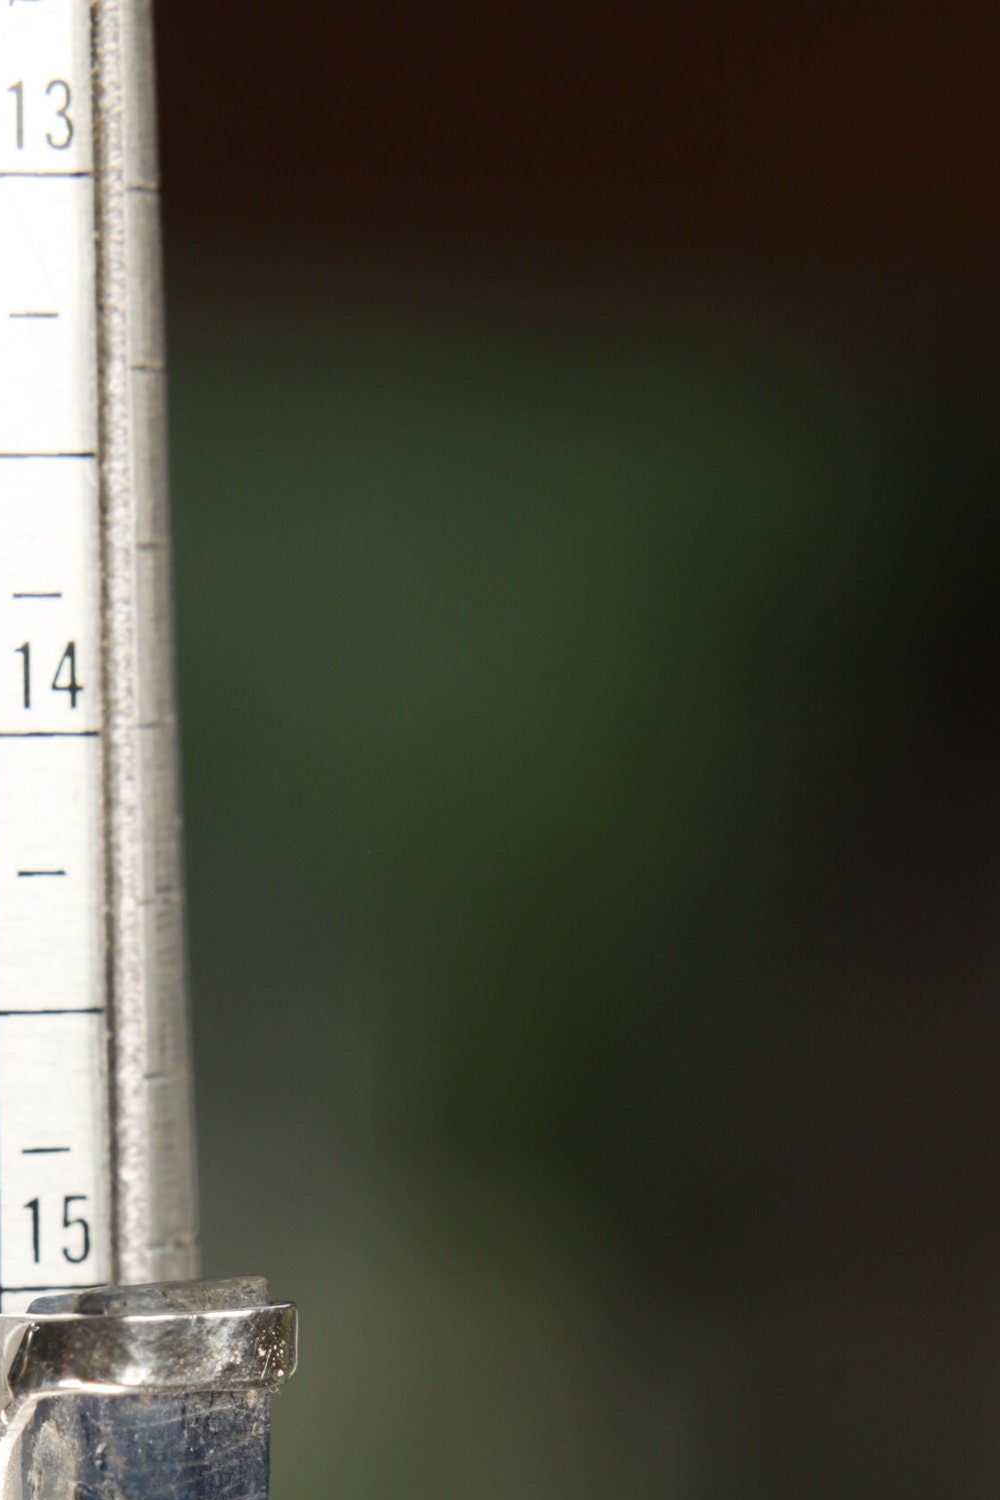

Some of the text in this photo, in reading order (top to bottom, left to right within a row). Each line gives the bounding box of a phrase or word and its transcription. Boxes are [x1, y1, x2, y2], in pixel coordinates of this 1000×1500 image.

[6, 81, 76, 151] 13
[14, 640, 84, 709] 14
[23, 1195, 91, 1264] 15
